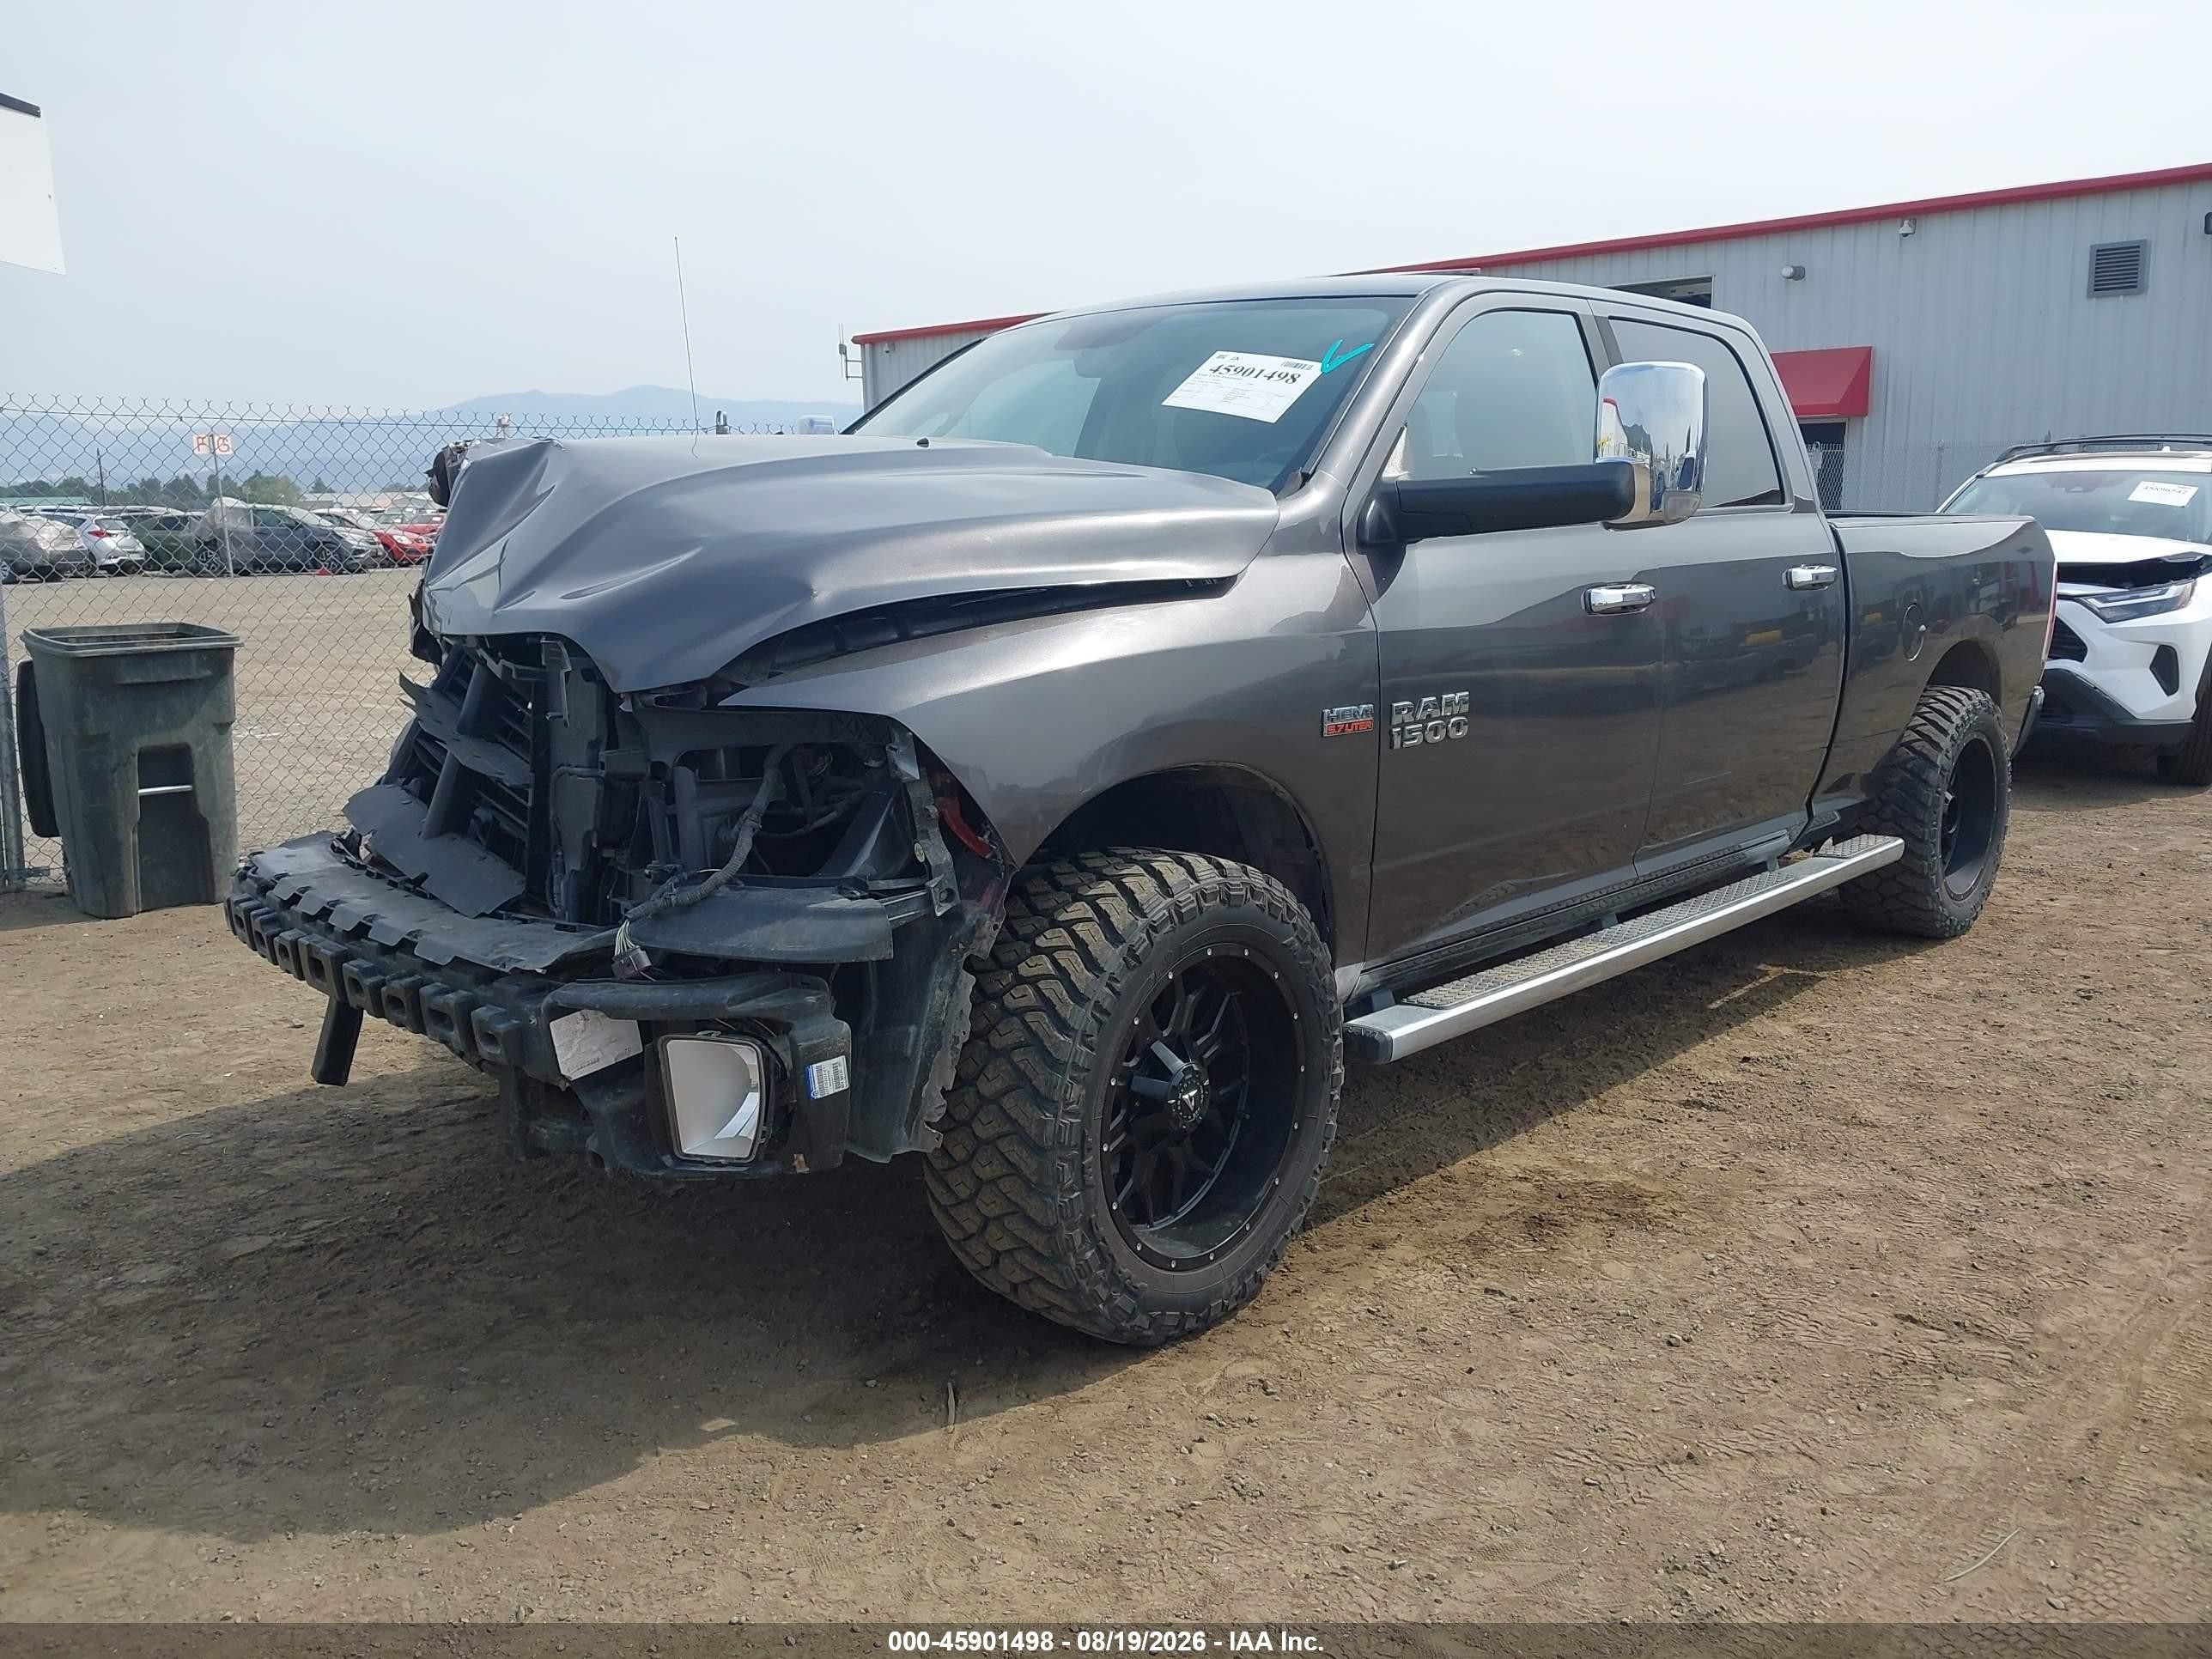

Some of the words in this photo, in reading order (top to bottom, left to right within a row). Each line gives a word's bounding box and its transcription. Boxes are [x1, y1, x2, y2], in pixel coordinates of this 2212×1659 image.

[1208, 363, 1302, 386] 45901498
[1390, 690, 1470, 726] RAM
[1327, 723, 1345, 735] 5.7
[1345, 720, 1372, 732] LITER
[1390, 715, 1469, 750] 1500
